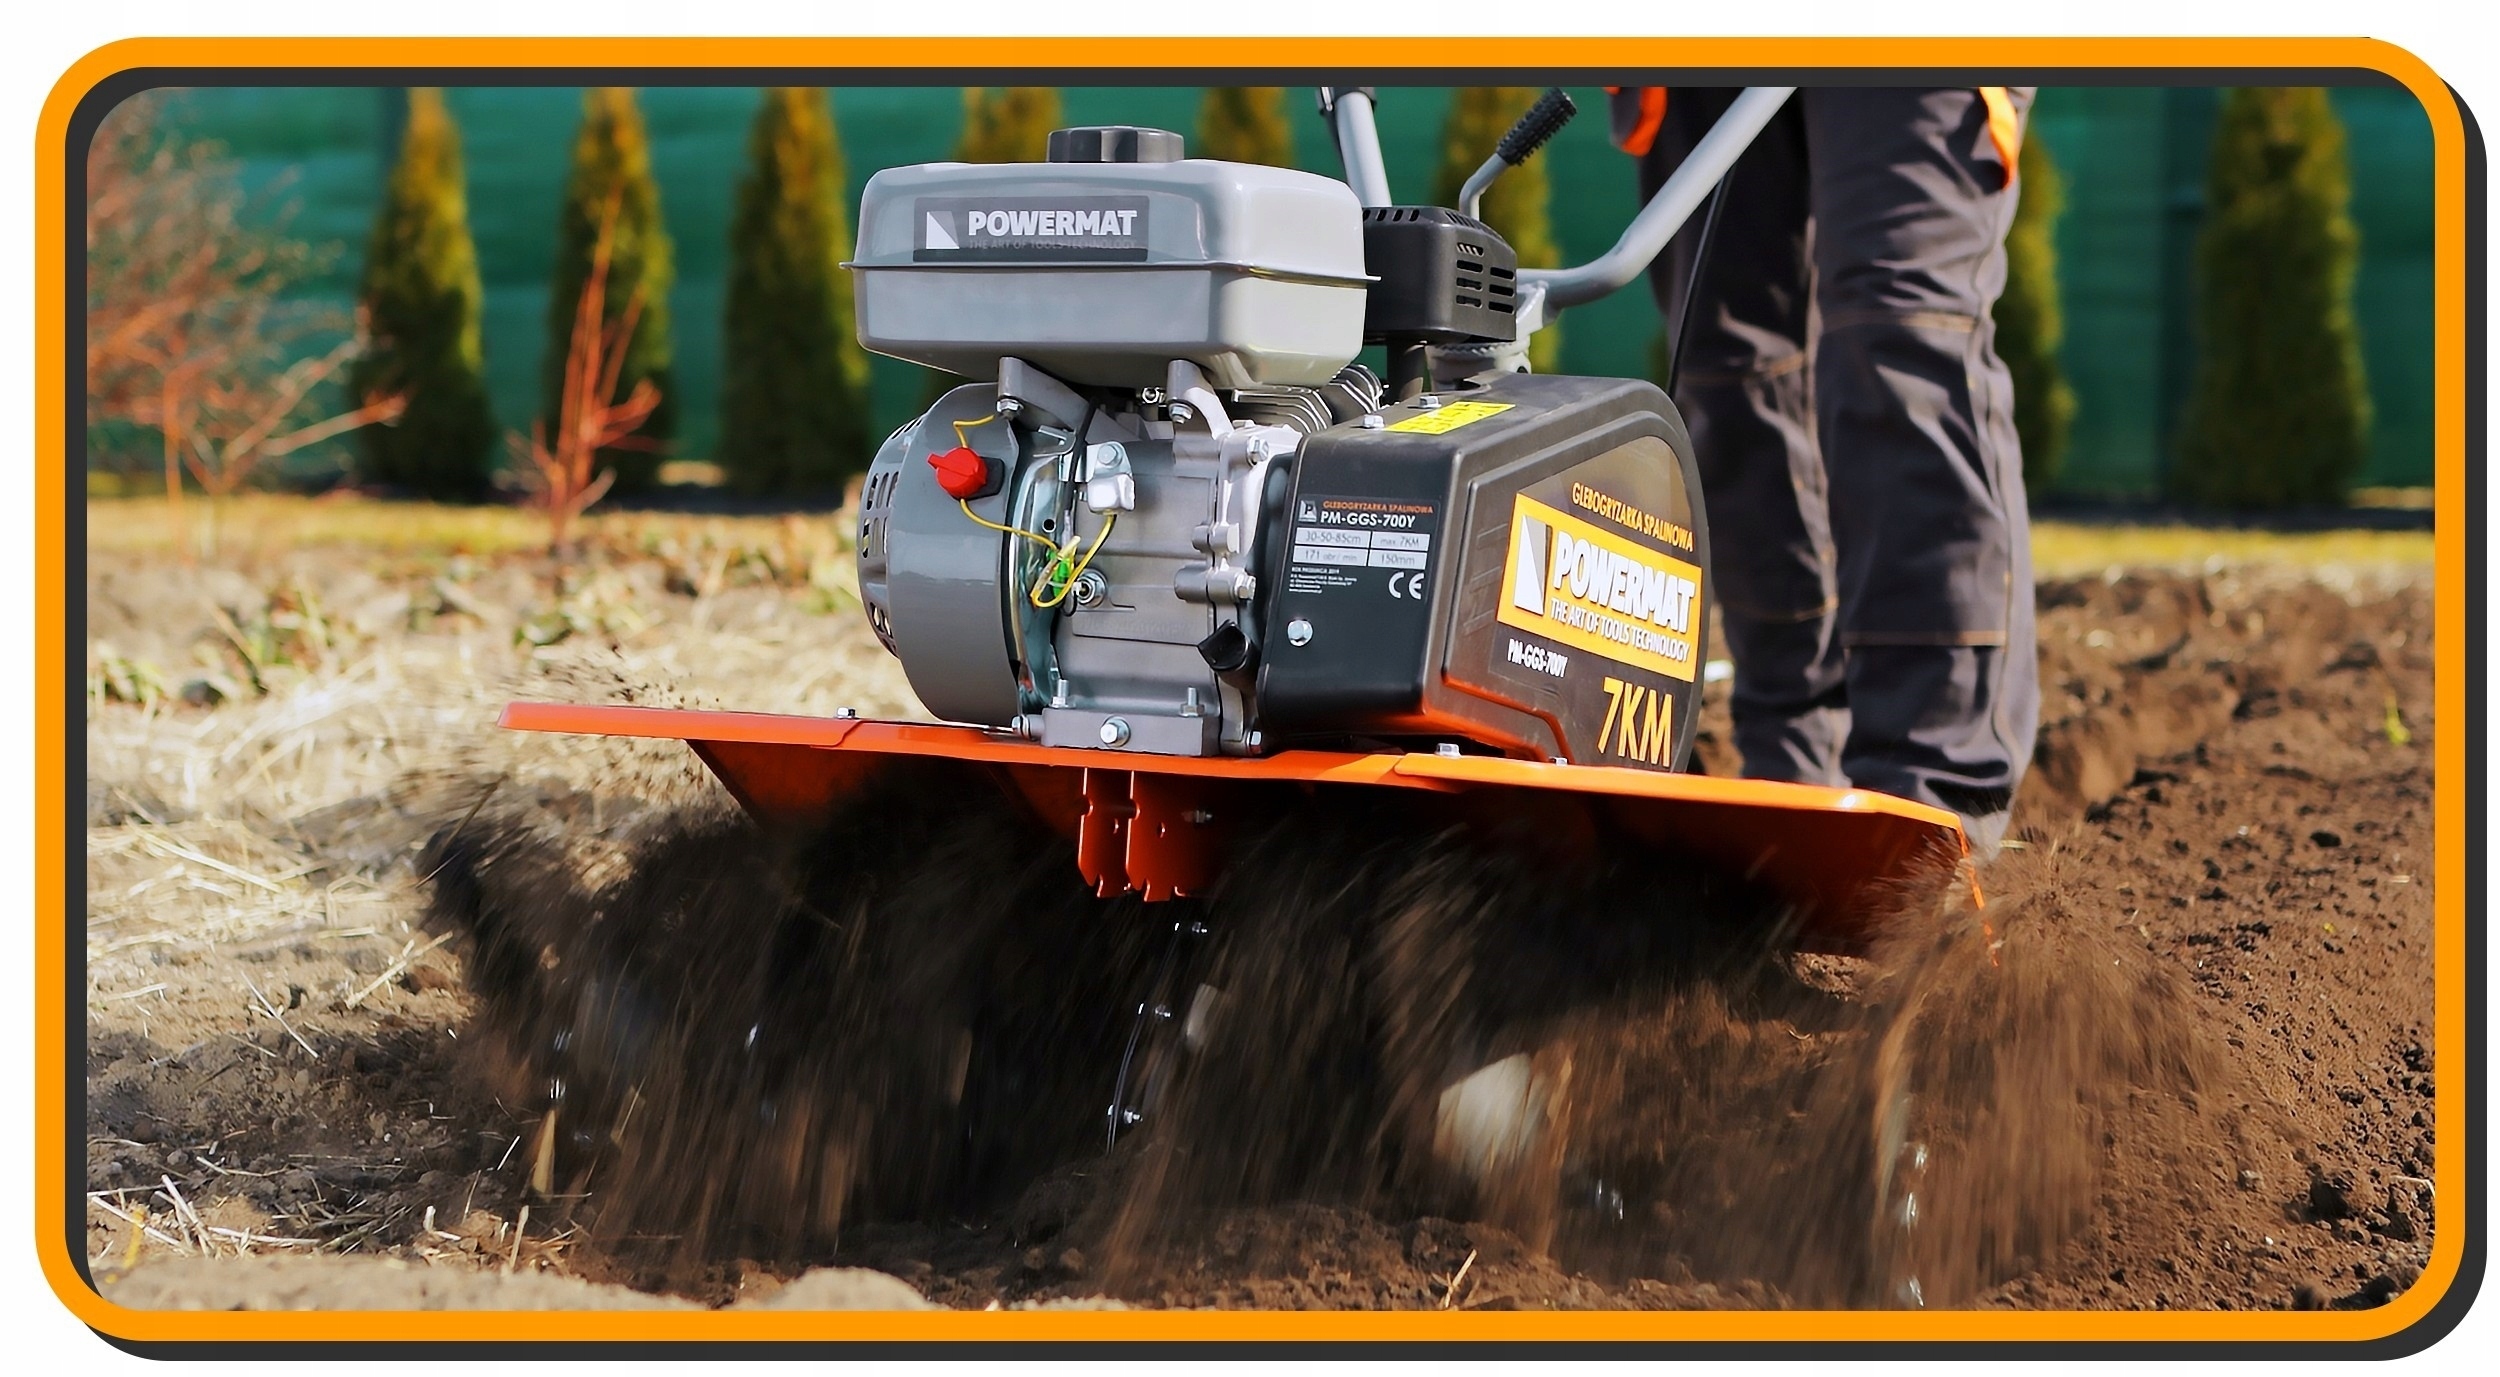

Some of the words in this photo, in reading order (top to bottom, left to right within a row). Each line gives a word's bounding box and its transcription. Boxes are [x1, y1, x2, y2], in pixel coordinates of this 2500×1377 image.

[967, 210, 1138, 237] POWERMAT
[1323, 500, 1388, 512] GLEBOGRYZARKA
[1389, 503, 1434, 514] SPALINOWA
[1572, 481, 1643, 535] GLEBOGRYZARKA
[1643, 514, 1694, 552] SPALINOWA
[1320, 510, 1416, 528] PM-GGS-700Y
[1306, 530, 1361, 545] 30-50-85cm
[1400, 534, 1419, 547] 7KM
[1305, 549, 1320, 559] 171
[1381, 553, 1415, 566] 150mm
[1553, 530, 1695, 634] POWERMAT
[1551, 597, 1568, 624] THE
[1568, 604, 1587, 630] ART
[1586, 611, 1600, 634] OF
[1600, 615, 1630, 645] TOOLS
[1630, 625, 1691, 663] TECHNOLOGY
[1507, 638, 1568, 678] PM-GGS-700Y
[1597, 676, 1673, 768] 7KM
